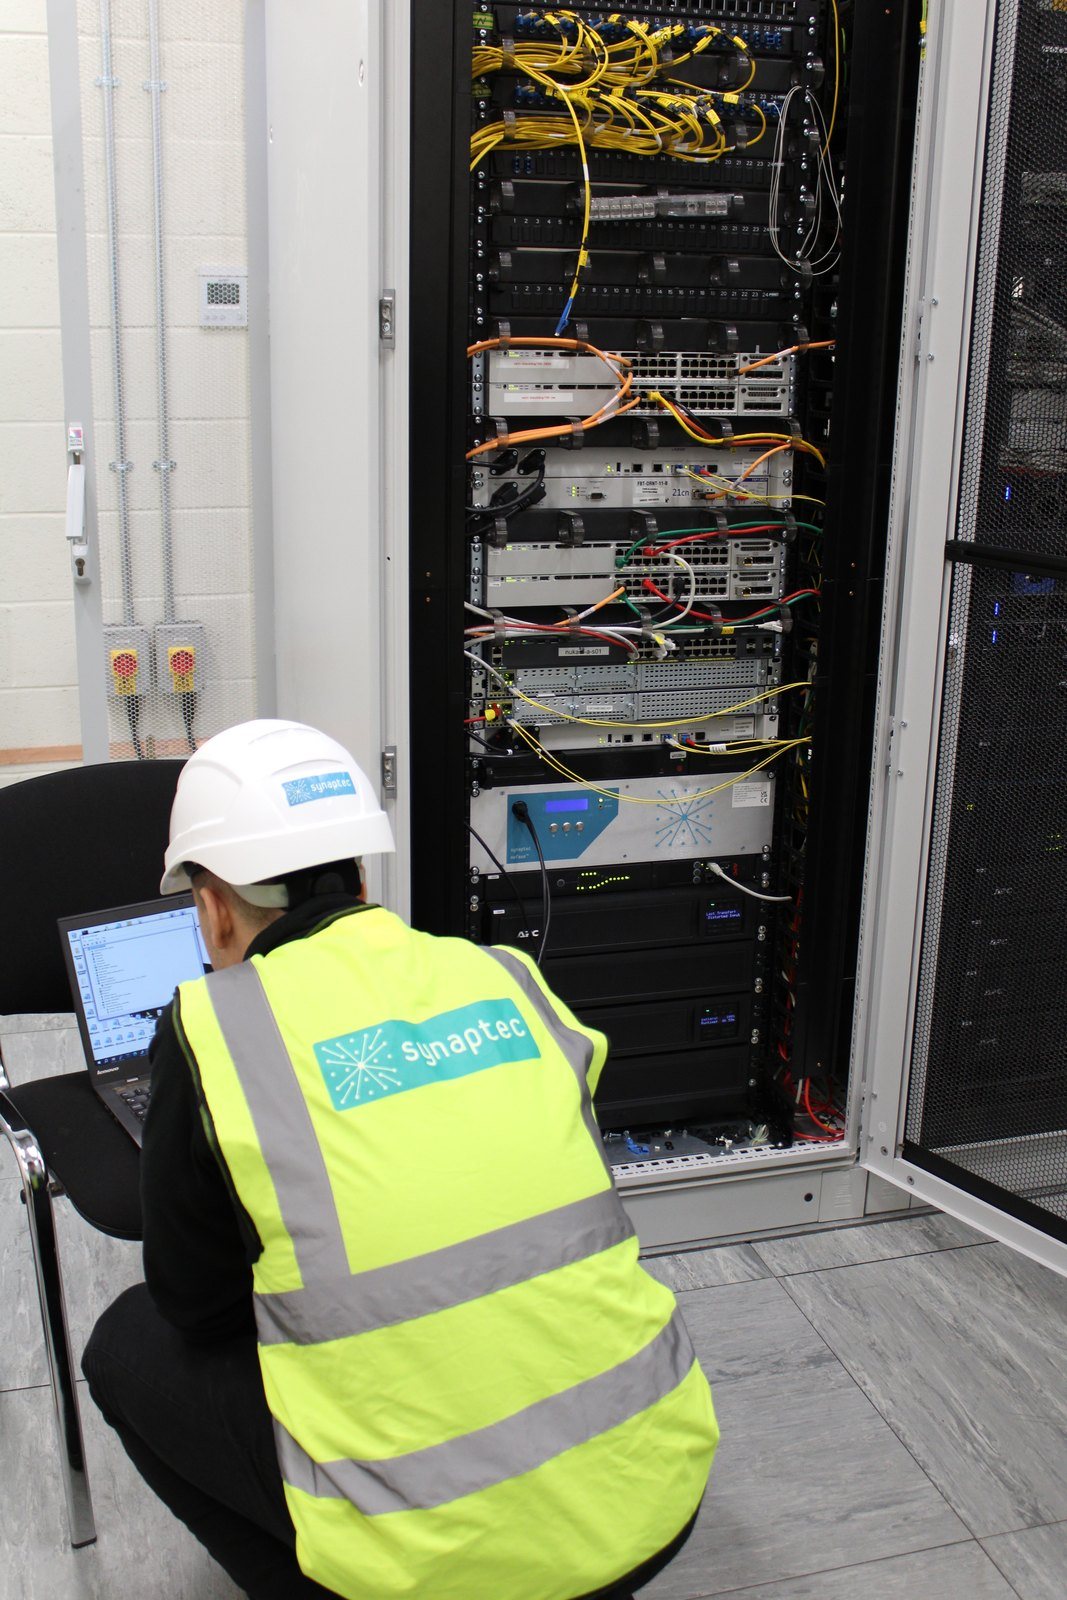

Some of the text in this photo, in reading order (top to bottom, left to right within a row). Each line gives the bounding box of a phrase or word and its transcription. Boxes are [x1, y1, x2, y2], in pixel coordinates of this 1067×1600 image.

[310, 778, 352, 792] synaptec
[401, 1018, 526, 1066] synaptec
[97, 1066, 119, 1075] lenovo
